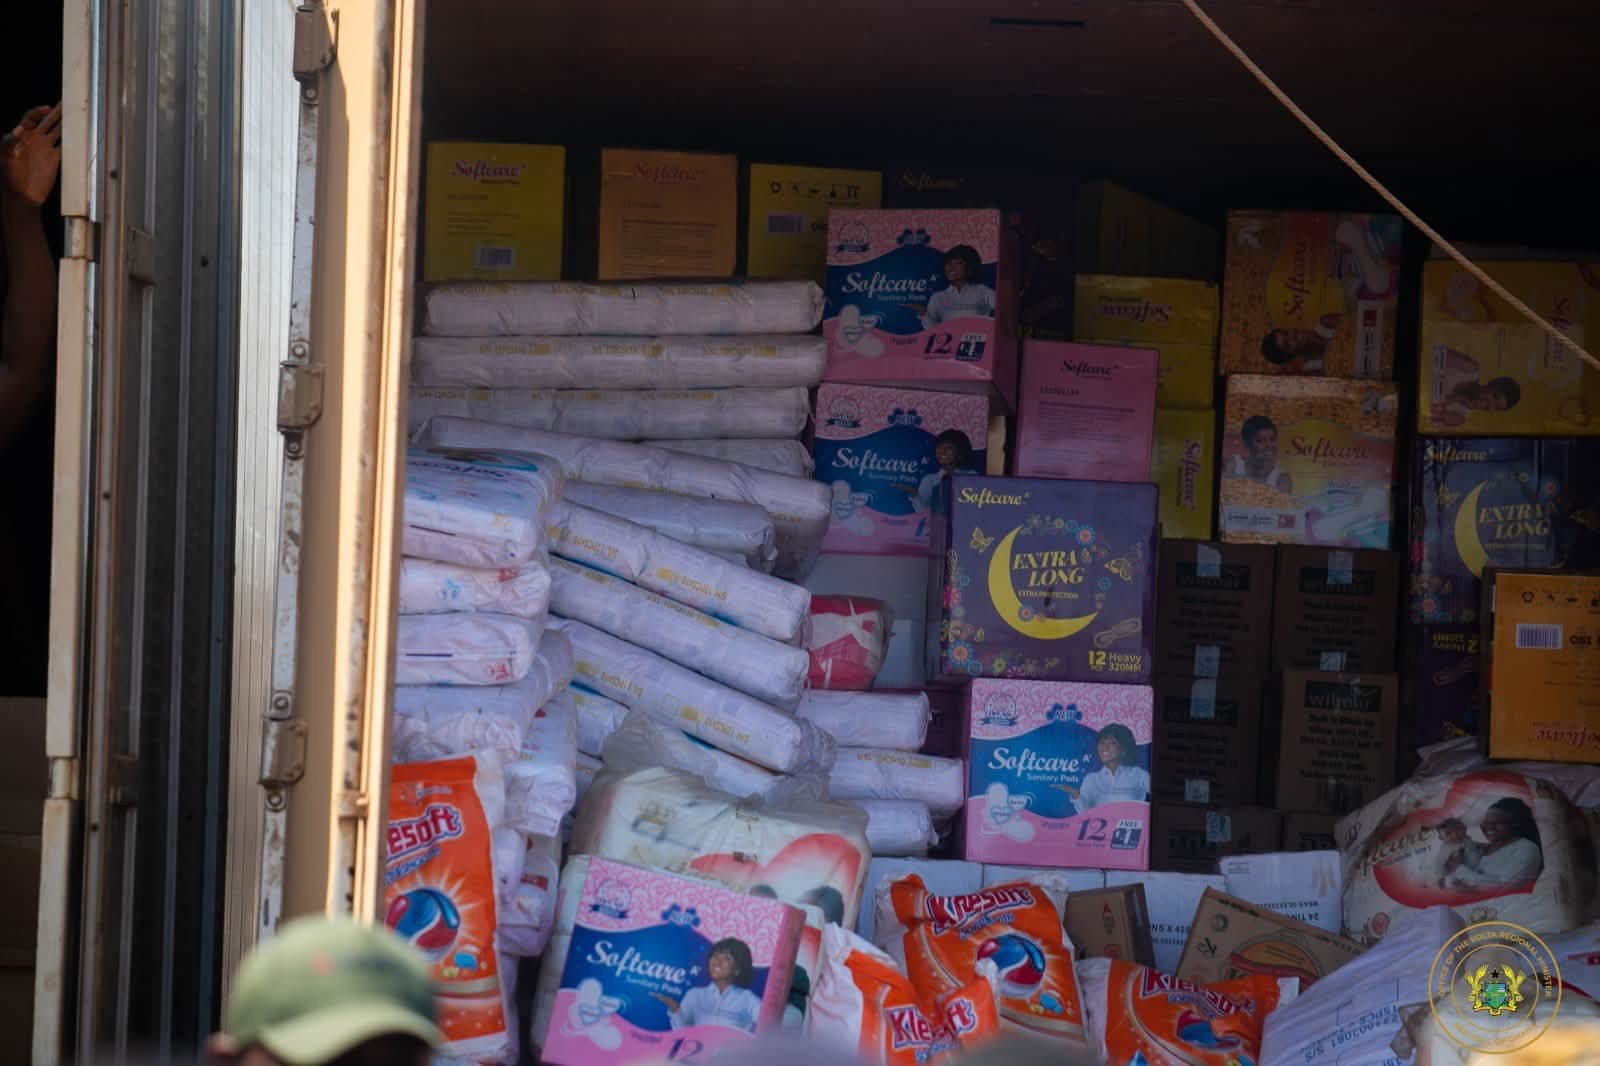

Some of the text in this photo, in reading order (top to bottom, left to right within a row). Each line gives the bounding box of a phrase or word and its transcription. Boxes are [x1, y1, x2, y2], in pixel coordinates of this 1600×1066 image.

[841, 272, 928, 299] Softcare
[924, 333, 953, 354] 12
[832, 447, 919, 476] Softcare
[957, 487, 1024, 509] Softcare
[1495, 520, 1549, 540] LONG
[1012, 549, 1078, 571] EXTRA
[1027, 566, 1086, 587] LONG
[1088, 650, 1106, 665] 12
[1109, 652, 1142, 664] Heavy
[987, 746, 1080, 777] Softcare
[1077, 817, 1107, 841] 12
[586, 940, 687, 982] Softcare
